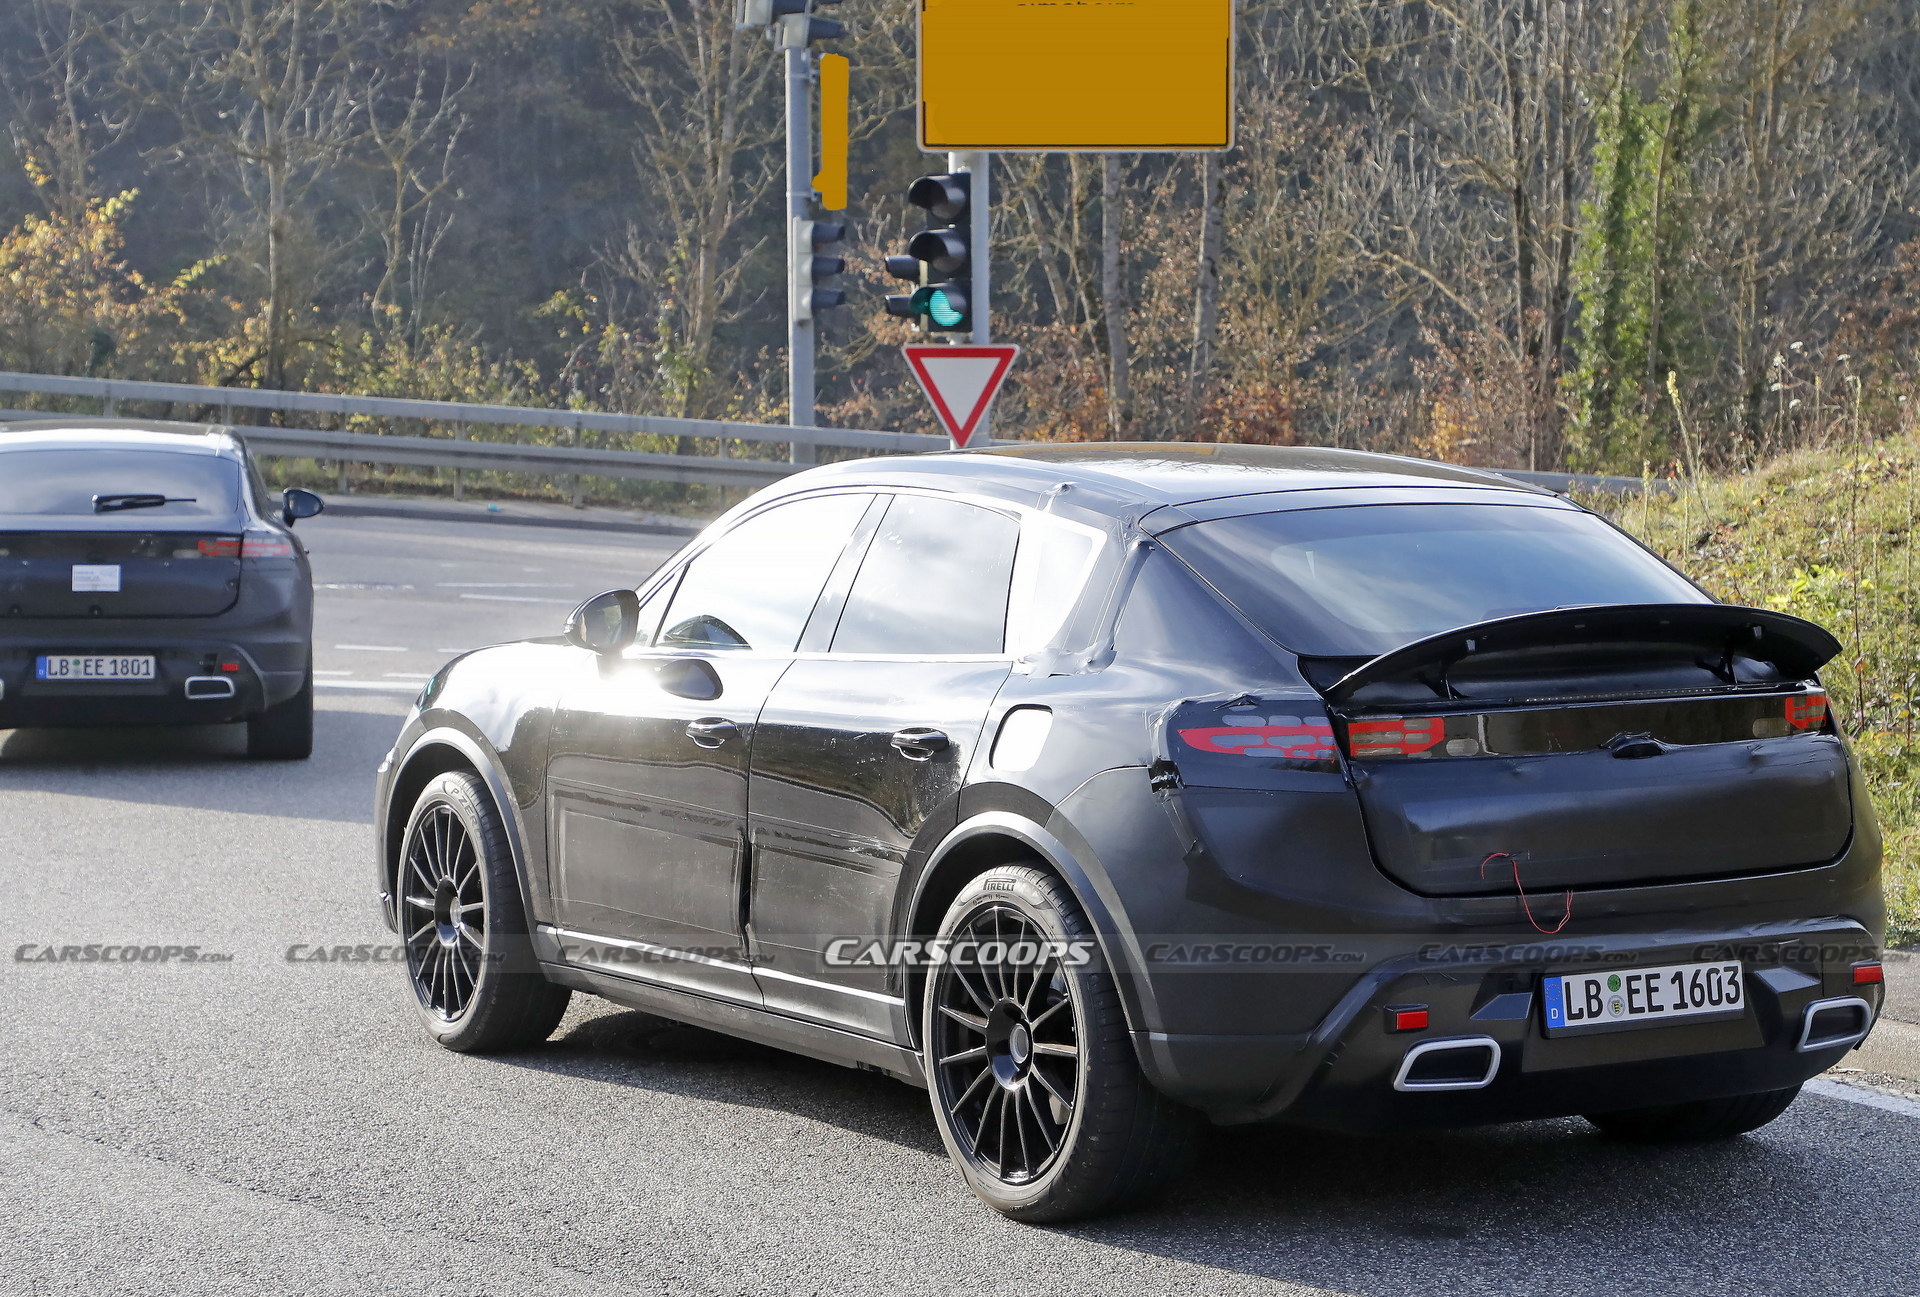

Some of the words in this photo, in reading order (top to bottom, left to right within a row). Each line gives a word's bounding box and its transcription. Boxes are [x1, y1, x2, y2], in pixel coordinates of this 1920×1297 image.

[48, 658, 69, 676] LB
[83, 658, 104, 676] EE
[109, 658, 151, 676] 1801
[983, 877, 1017, 892] PIRELLI
[1551, 1008, 1559, 1019] D
[1564, 979, 1604, 1021] LB
[1625, 973, 1665, 1014] EE
[1670, 966, 1741, 1011] 1603
